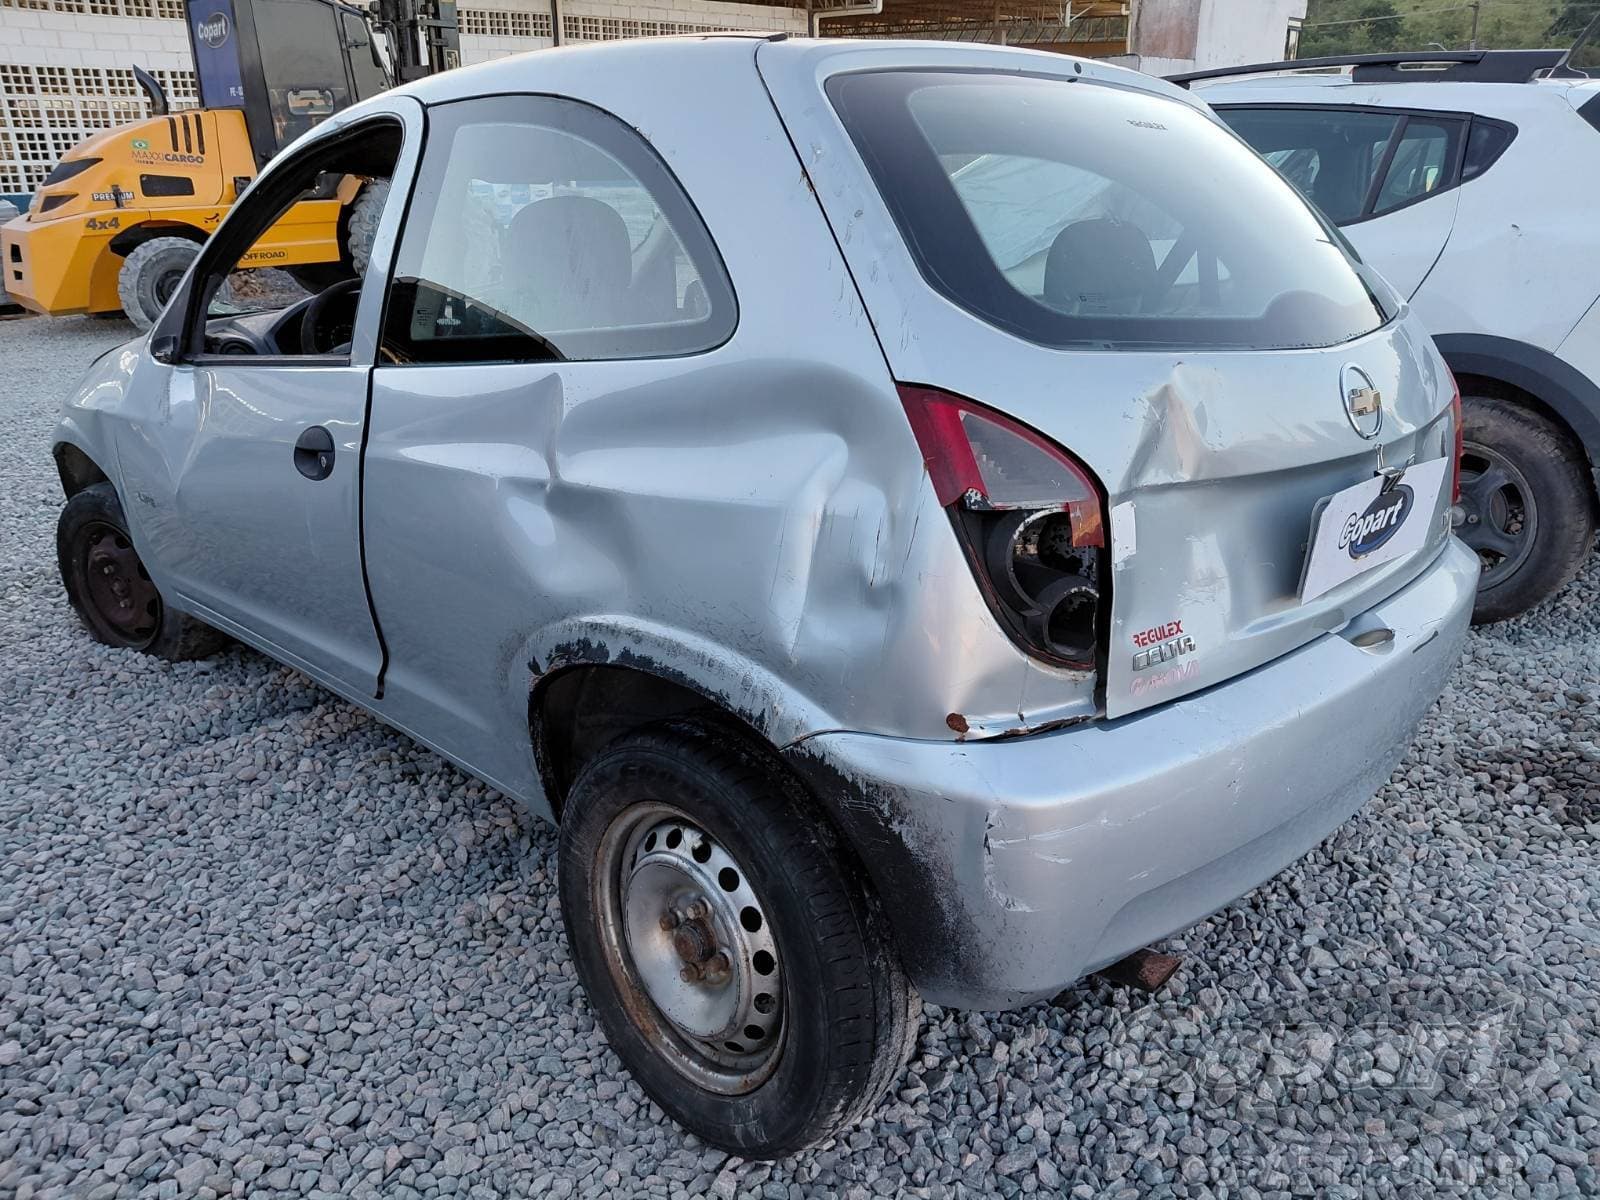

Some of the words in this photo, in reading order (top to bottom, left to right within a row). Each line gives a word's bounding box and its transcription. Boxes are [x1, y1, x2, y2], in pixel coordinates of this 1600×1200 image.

[198, 17, 226, 42] Copart
[93, 192, 134, 201] PREMUM
[85, 216, 121, 230] 4x4
[259, 251, 286, 260] ROAD
[1338, 495, 1405, 550] Copart
[1133, 619, 1184, 648] REGULEX
